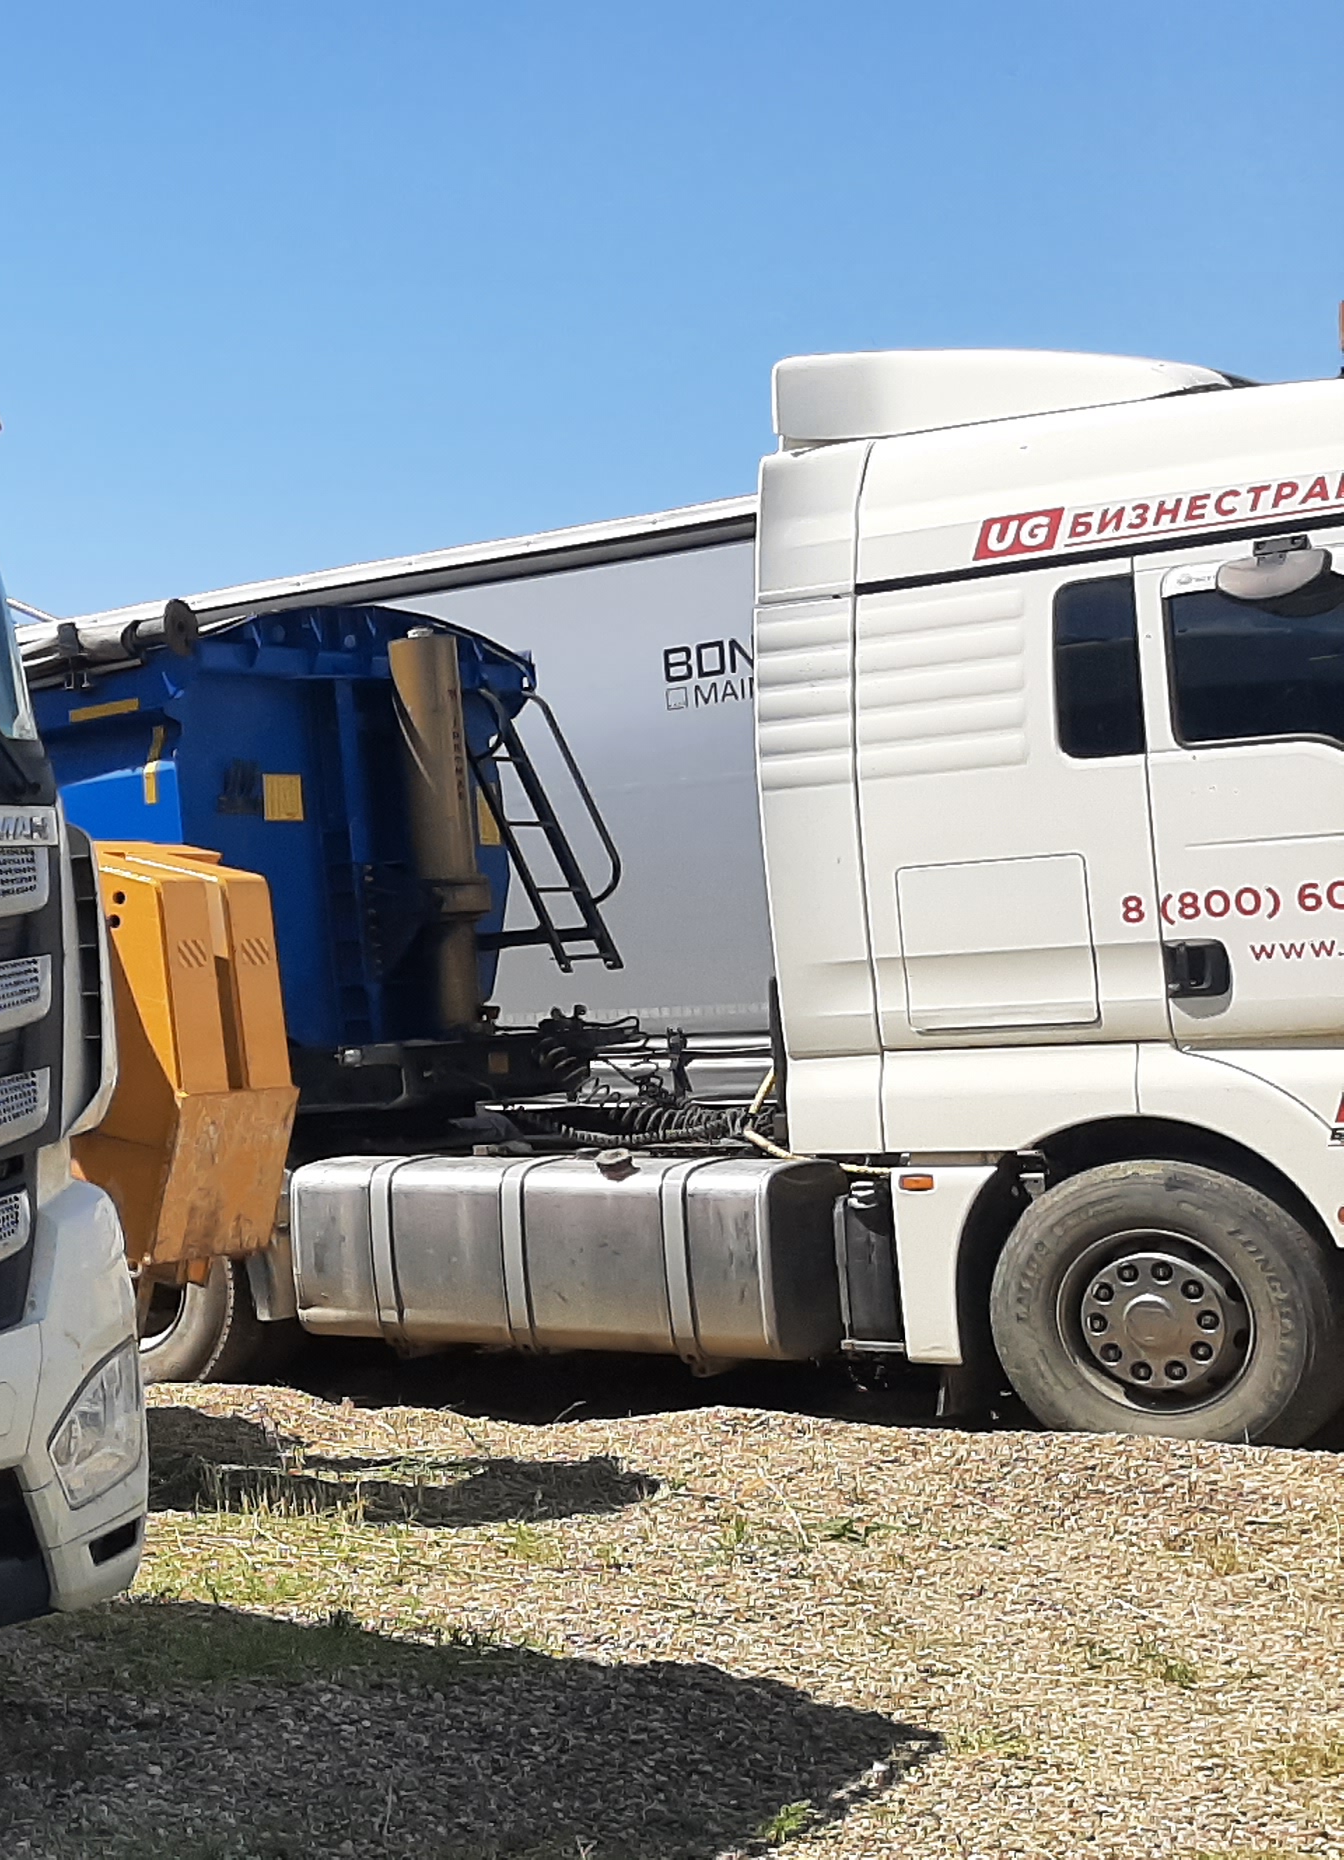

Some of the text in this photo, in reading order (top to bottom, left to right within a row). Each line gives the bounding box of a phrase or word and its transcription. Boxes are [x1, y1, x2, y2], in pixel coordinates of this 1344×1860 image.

[986, 515, 1052, 551] UG
[1121, 895, 1146, 924] 8
[1160, 885, 1281, 926] (800)
